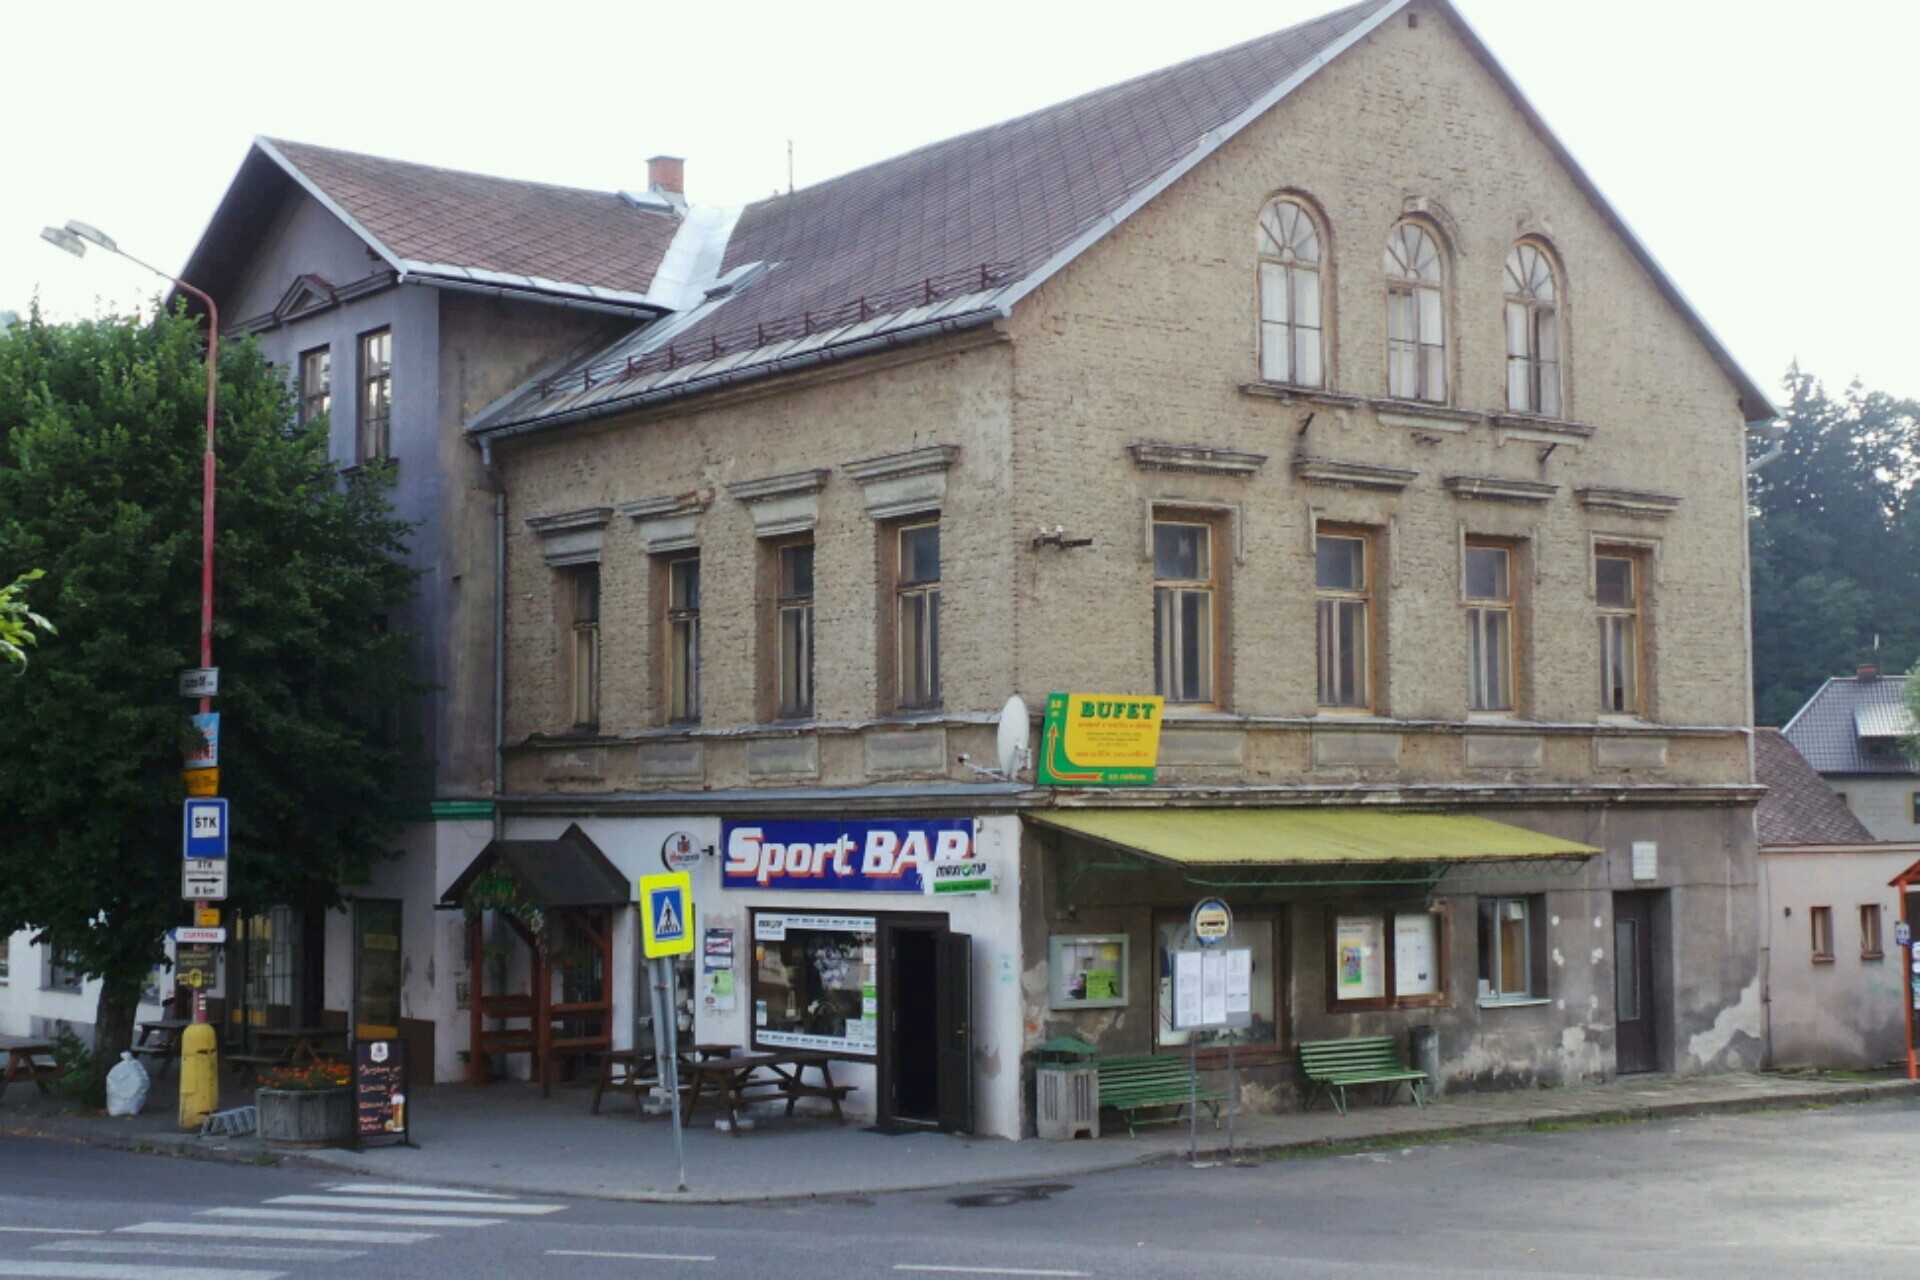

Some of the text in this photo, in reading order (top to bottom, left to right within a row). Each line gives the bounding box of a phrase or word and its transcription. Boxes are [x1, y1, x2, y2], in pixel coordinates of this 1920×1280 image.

[1080, 701, 1156, 719] BUFET
[195, 816, 217, 828] STK
[725, 827, 975, 886] Sport BAR
